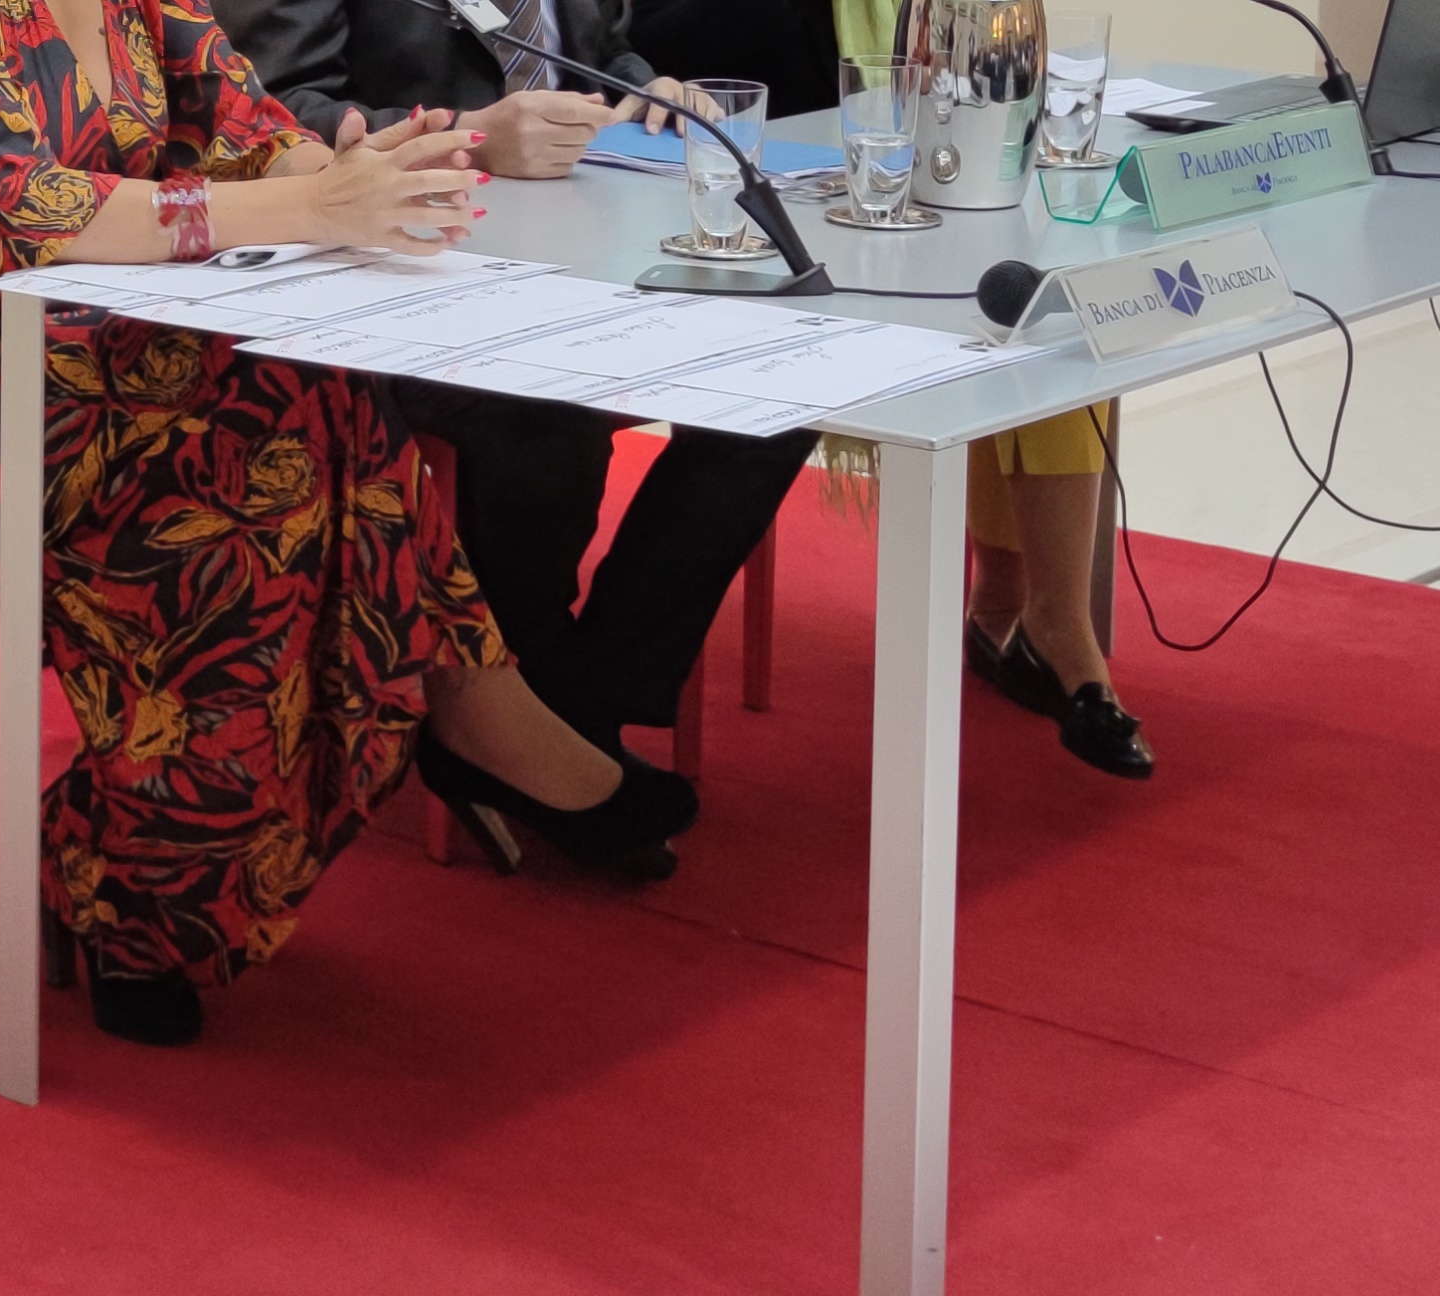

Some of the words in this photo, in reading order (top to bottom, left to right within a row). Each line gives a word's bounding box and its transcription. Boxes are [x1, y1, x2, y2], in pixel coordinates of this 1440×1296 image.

[1178, 127, 1333, 180] PALABANCAEVENTI
[1087, 296, 1145, 326] BANCA
[1145, 292, 1164, 310] DI
[1202, 263, 1277, 297] PIACENZA
